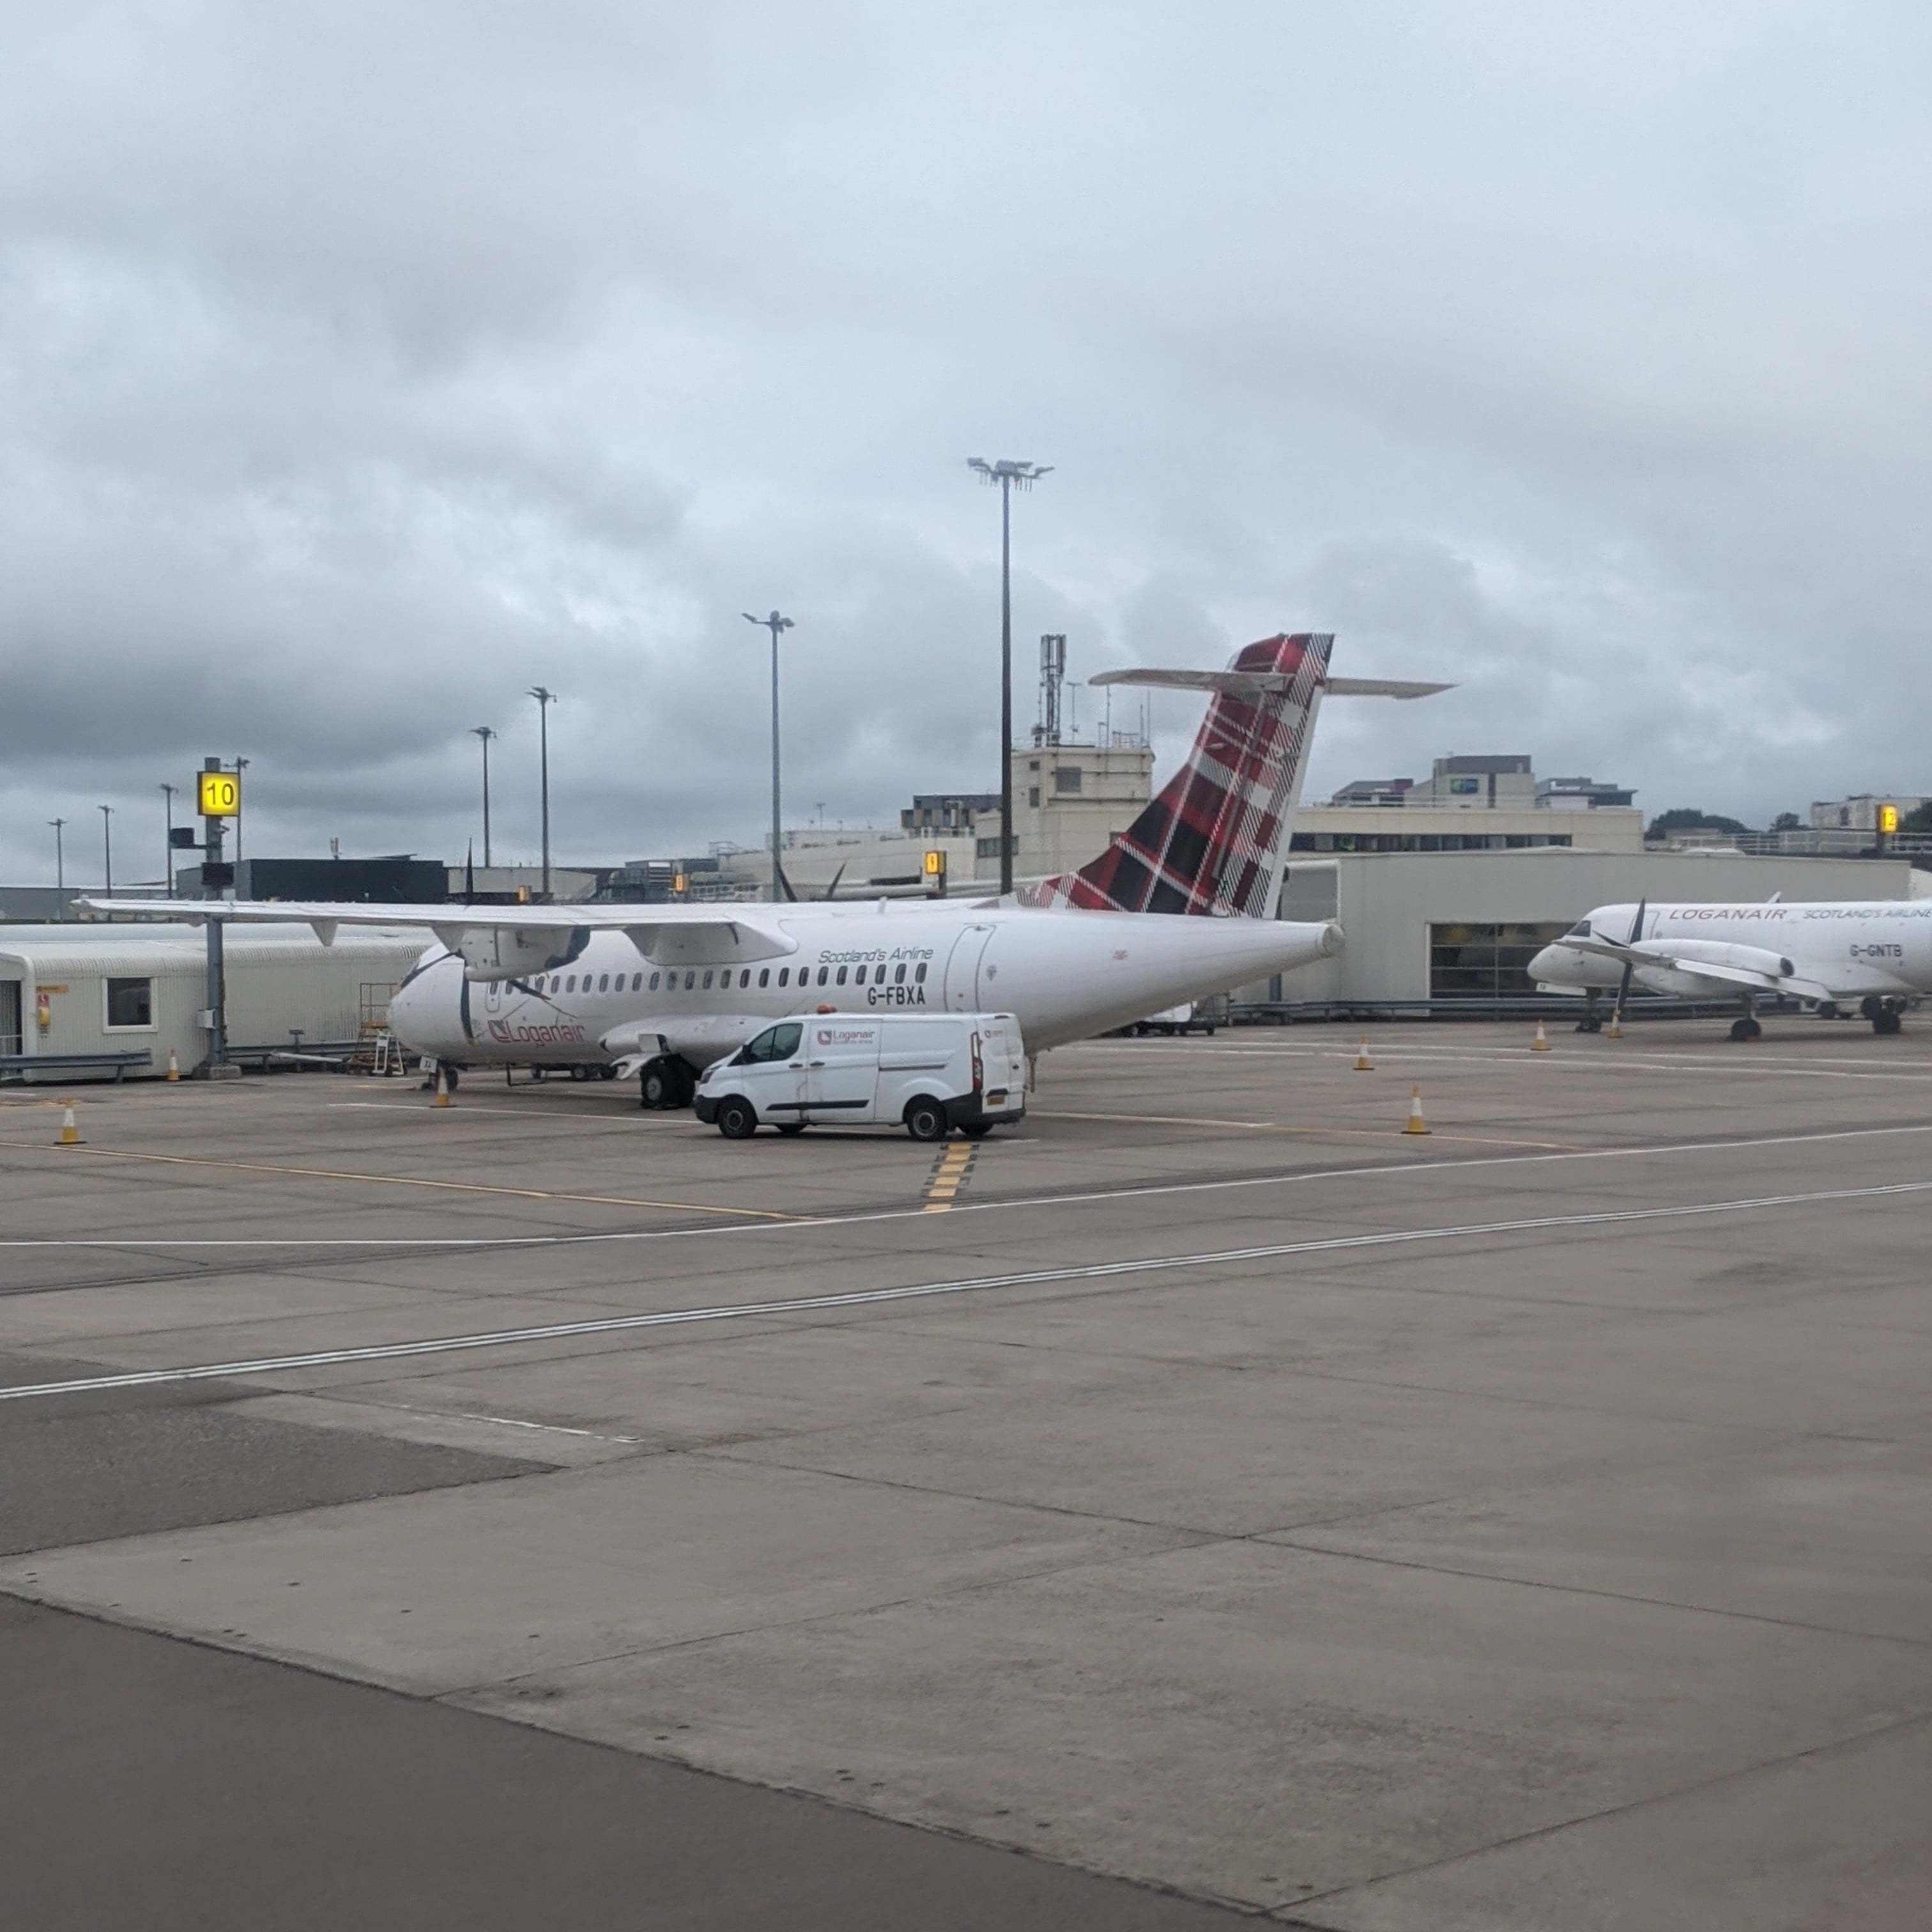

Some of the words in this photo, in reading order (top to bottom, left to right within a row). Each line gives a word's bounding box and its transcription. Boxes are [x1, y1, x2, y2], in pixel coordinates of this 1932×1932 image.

[206, 782, 234, 806] 10
[1882, 812, 1894, 826] 12
[1669, 909, 1788, 919] LOGANAIR
[818, 948, 887, 963] Scotland's
[889, 946, 933, 960] Airline
[1850, 944, 1902, 957] G-GNTB
[868, 986, 925, 1006] G-FBXA
[505, 1020, 585, 1046] Loganair
[833, 1029, 875, 1041] Loganair
